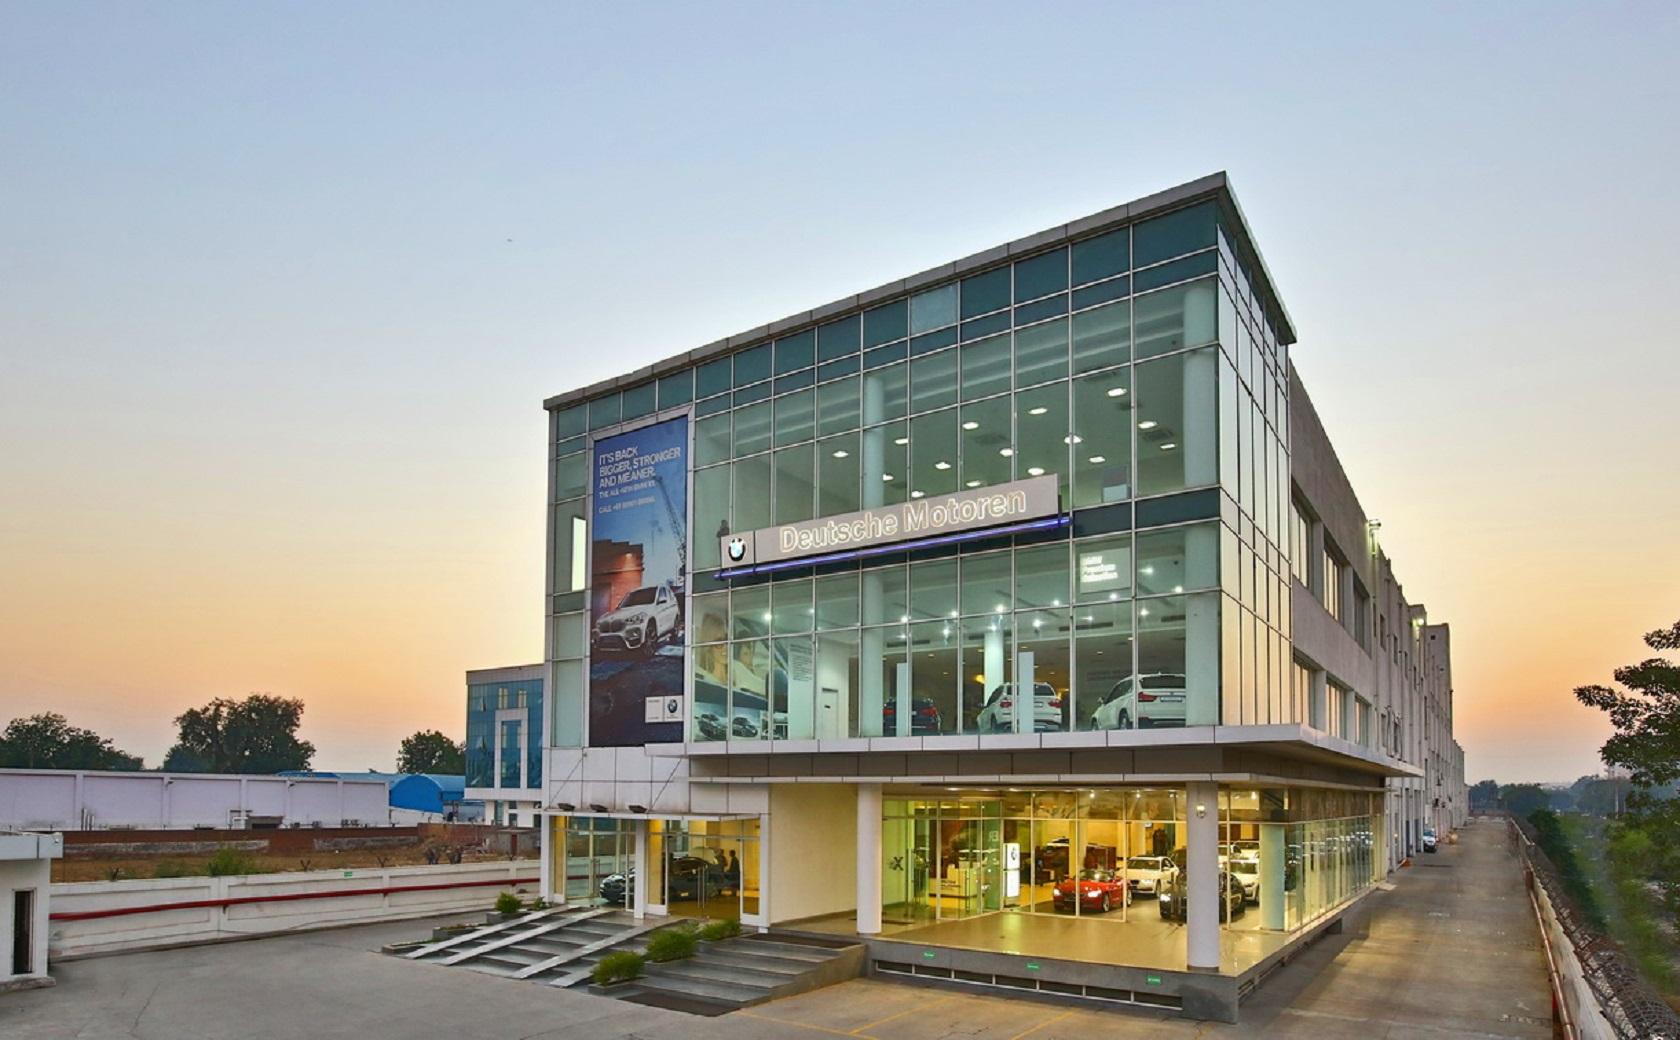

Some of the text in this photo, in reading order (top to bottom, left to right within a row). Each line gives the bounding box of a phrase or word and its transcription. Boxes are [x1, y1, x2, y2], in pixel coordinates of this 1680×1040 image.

[600, 446, 638, 465] IT'S BACK
[633, 447, 681, 469] STRONGER
[600, 476, 616, 488] AND
[779, 490, 1026, 552] Deutsche Motoren
